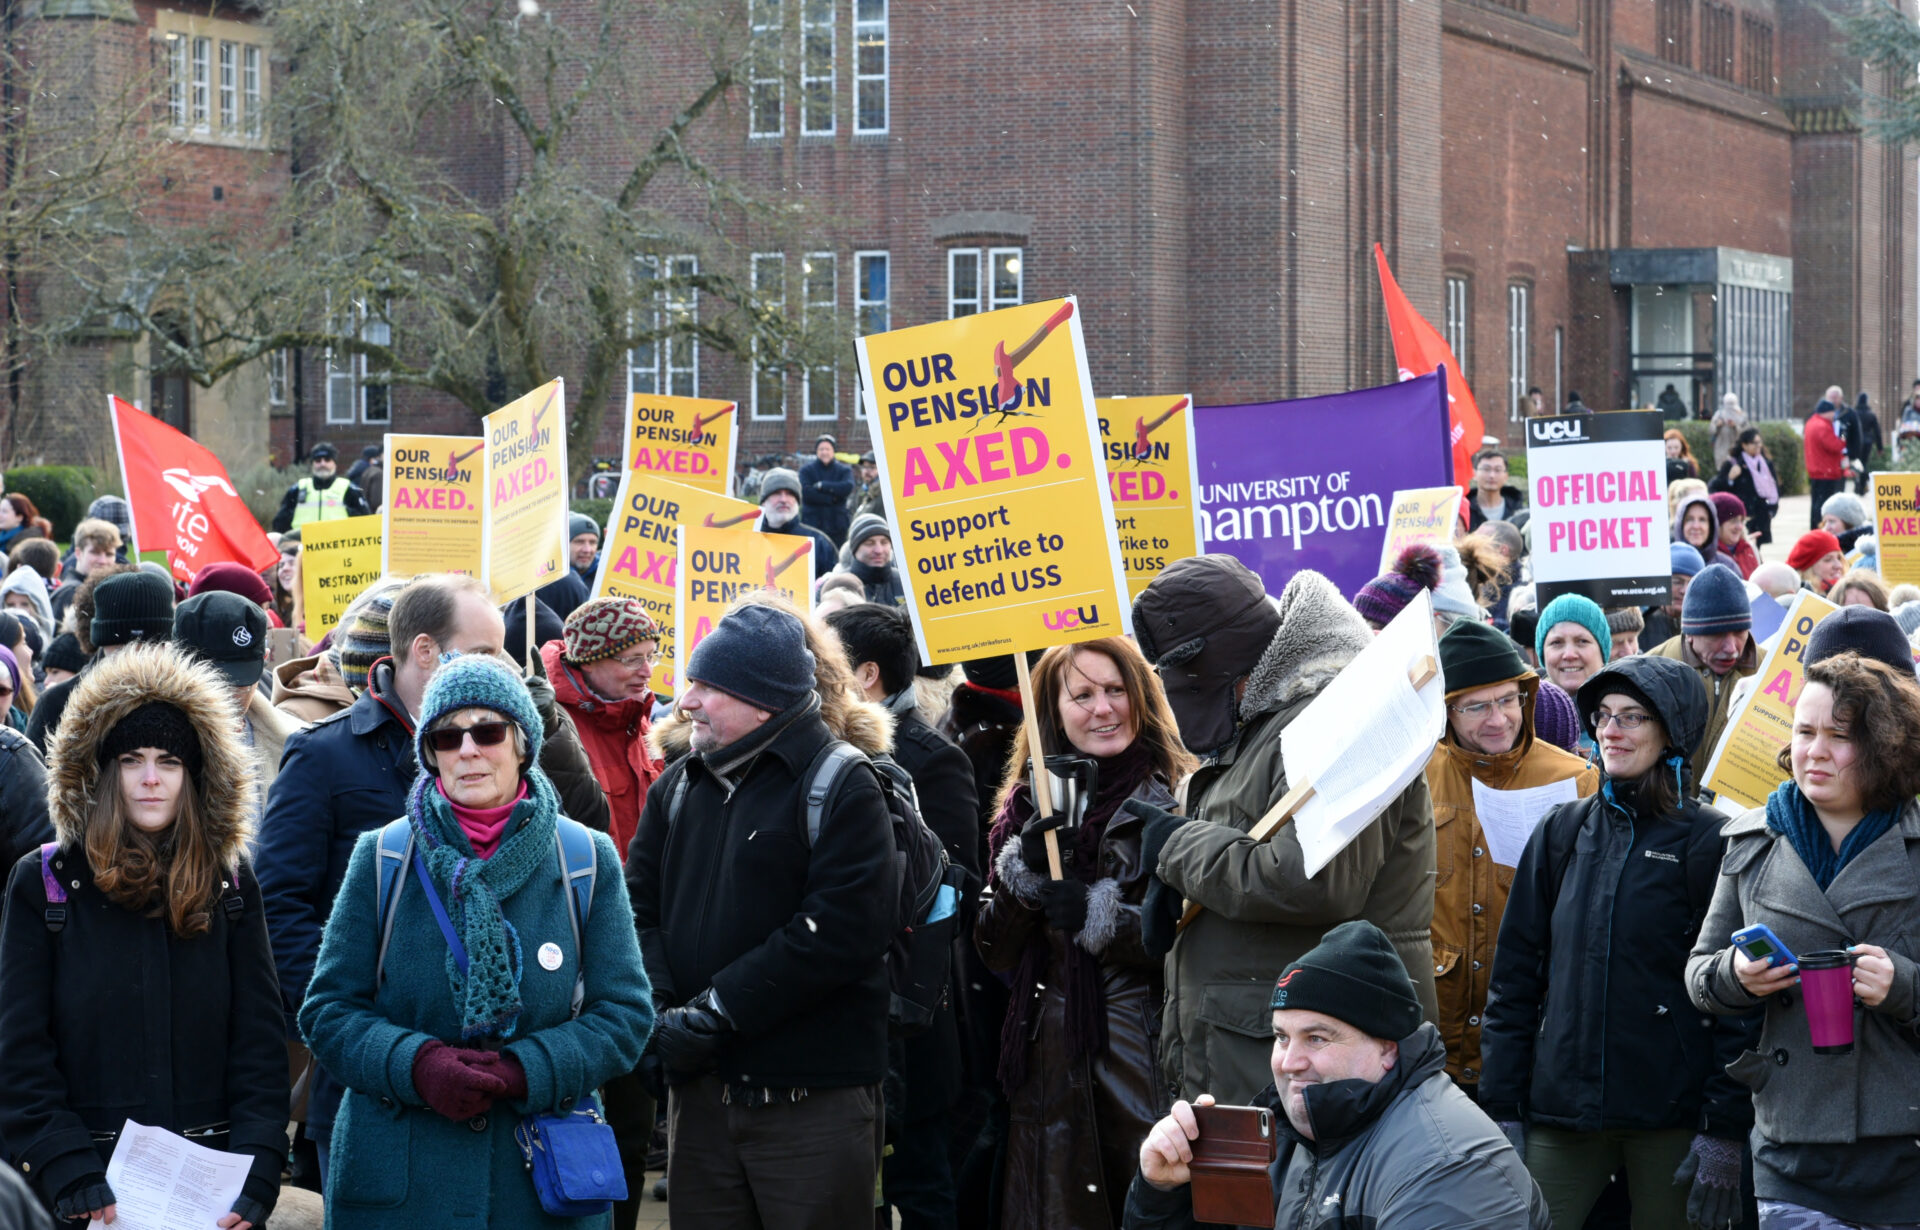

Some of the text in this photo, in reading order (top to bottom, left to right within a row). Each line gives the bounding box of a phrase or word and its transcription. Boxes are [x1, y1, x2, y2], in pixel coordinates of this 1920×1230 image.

[883, 353, 957, 392] OUR
[637, 408, 674, 423] OUR
[888, 377, 1051, 432] PENSION
[493, 419, 519, 447] OUR
[636, 426, 717, 446] PENSION
[395, 449, 430, 463] OUR
[493, 428, 550, 470] PENSION
[634, 447, 718, 476] AXED.
[902, 426, 1072, 497] AXED.
[395, 466, 471, 482] PENSION
[494, 457, 554, 508] AXED.
[1200, 471, 1350, 504] UNIVERSITY OF
[394, 486, 474, 510] AXED.
[1537, 470, 1661, 508] OFFICIAL
[1878, 485, 1902, 497] OUR
[632, 493, 680, 522] OUR
[1397, 502, 1419, 514] OUR
[910, 505, 1010, 542] Support
[1395, 516, 1443, 529] PENSION
[1549, 517, 1652, 553] PICKET
[917, 532, 1064, 574] our strike to
[1152, 537, 1169, 549] to
[343, 558, 352, 568] IS
[691, 549, 741, 575] OUR
[1134, 557, 1165, 571] USS
[319, 571, 382, 588] DESTROYIN
[925, 564, 1062, 607] defend USS
[1753, 705, 1780, 723] SUPPORT
